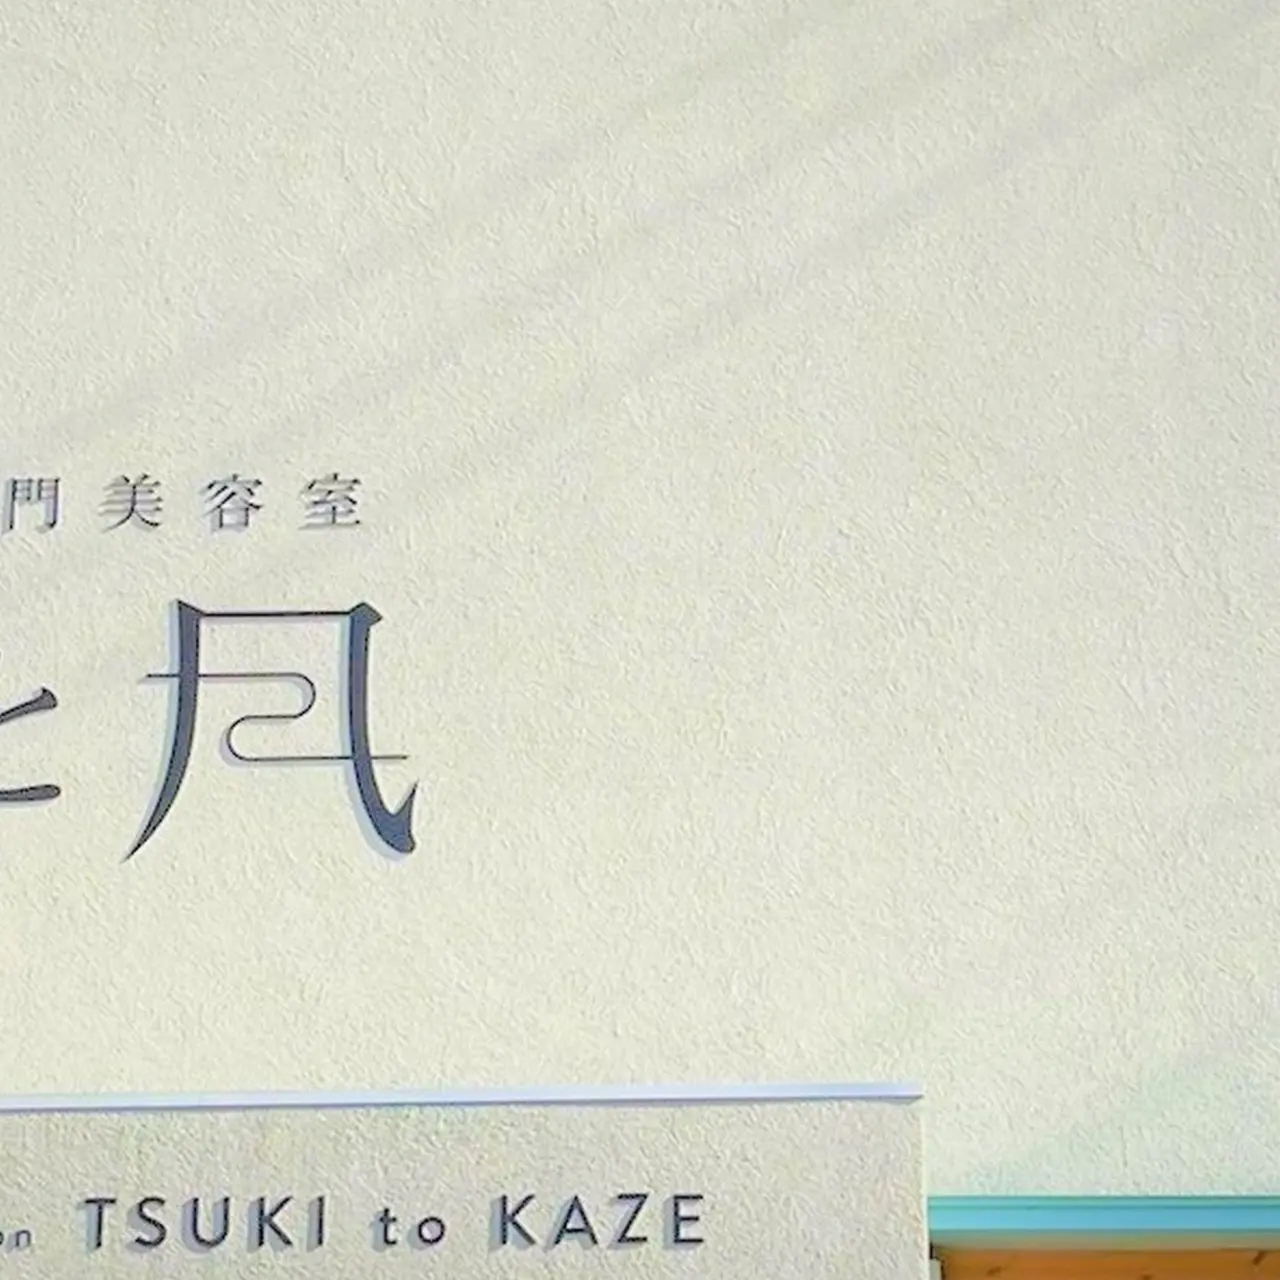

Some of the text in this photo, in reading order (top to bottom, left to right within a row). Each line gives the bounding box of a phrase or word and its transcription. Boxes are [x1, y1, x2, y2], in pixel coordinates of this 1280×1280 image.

[83, 1195, 328, 1250] TSUKI
[377, 1206, 448, 1246] to
[500, 1192, 707, 1247] KAZE
